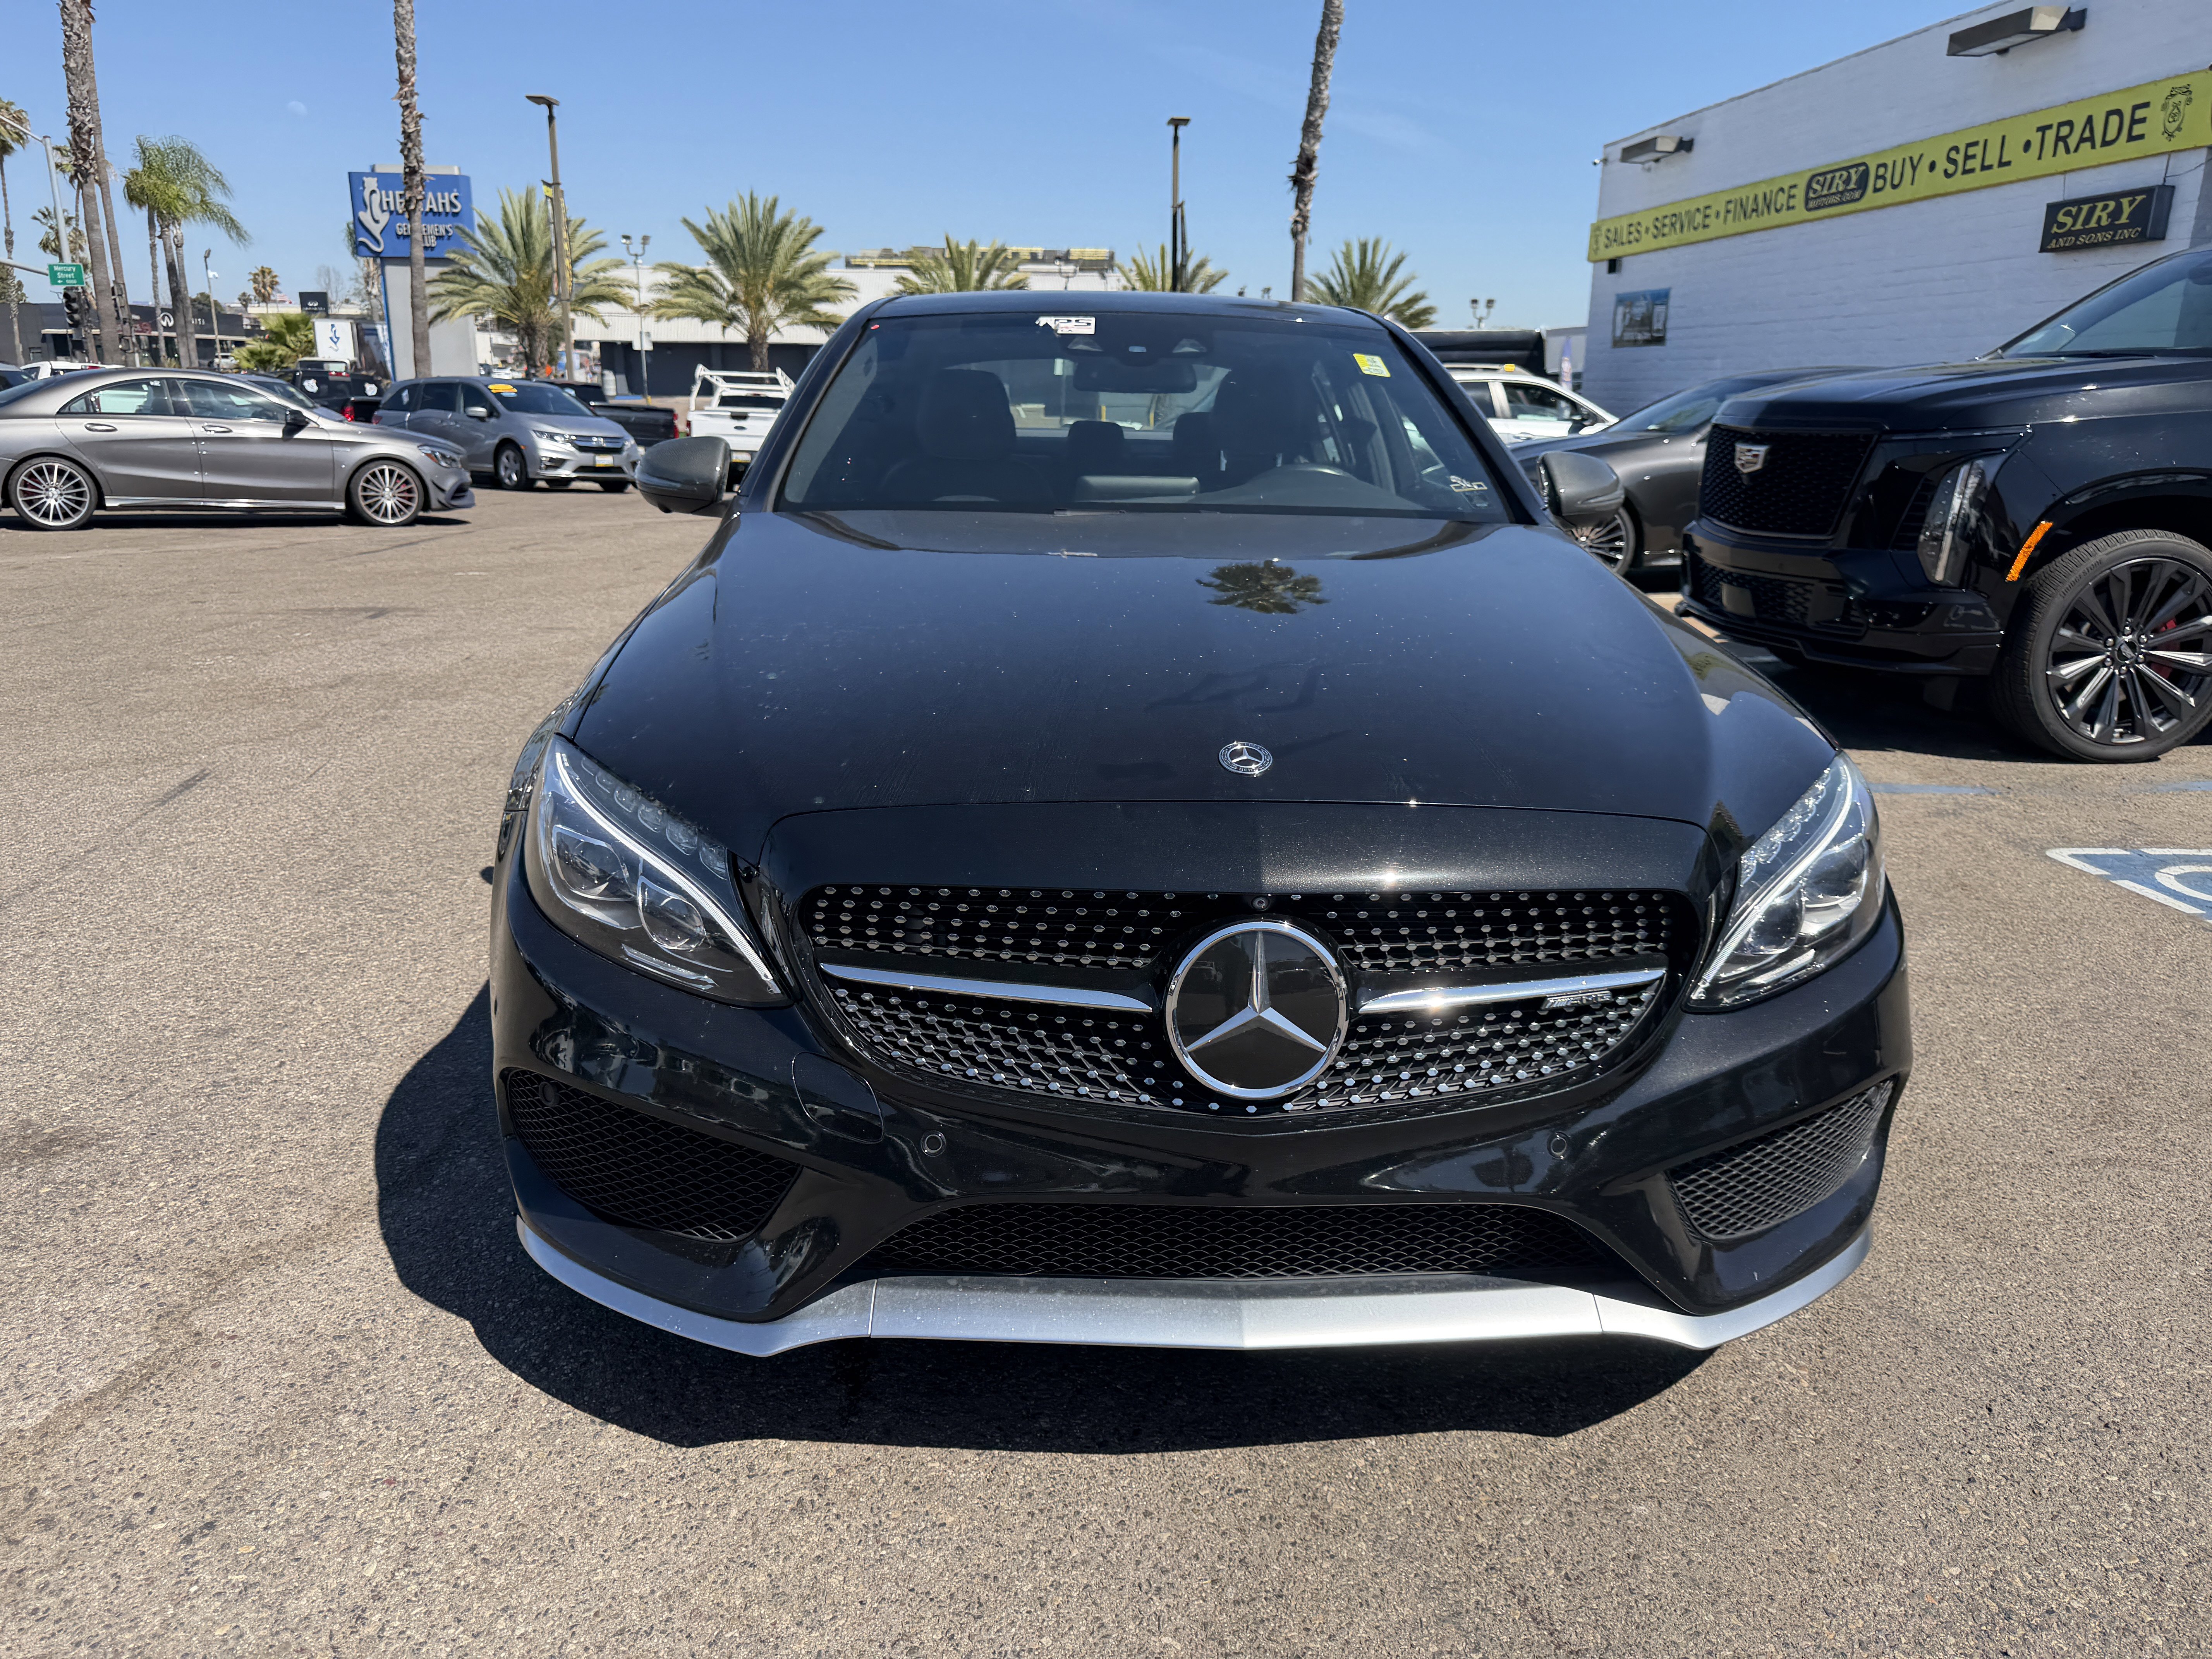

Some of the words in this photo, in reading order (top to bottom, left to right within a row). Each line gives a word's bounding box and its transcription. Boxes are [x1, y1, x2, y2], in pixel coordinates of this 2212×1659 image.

[1872, 153, 1923, 193] BUY
[1944, 135, 2012, 179] SELL
[2036, 101, 2151, 160] TRADE
[1808, 166, 1866, 199] SIRY
[1603, 221, 1643, 250] SALES
[1652, 205, 1712, 240] SERVICE
[1723, 184, 1798, 225] FINANCE
[2051, 195, 2147, 234] SIRY
[2047, 236, 2075, 249] AND
[2076, 231, 2114, 244] SONS
[2113, 227, 2142, 240] INC
